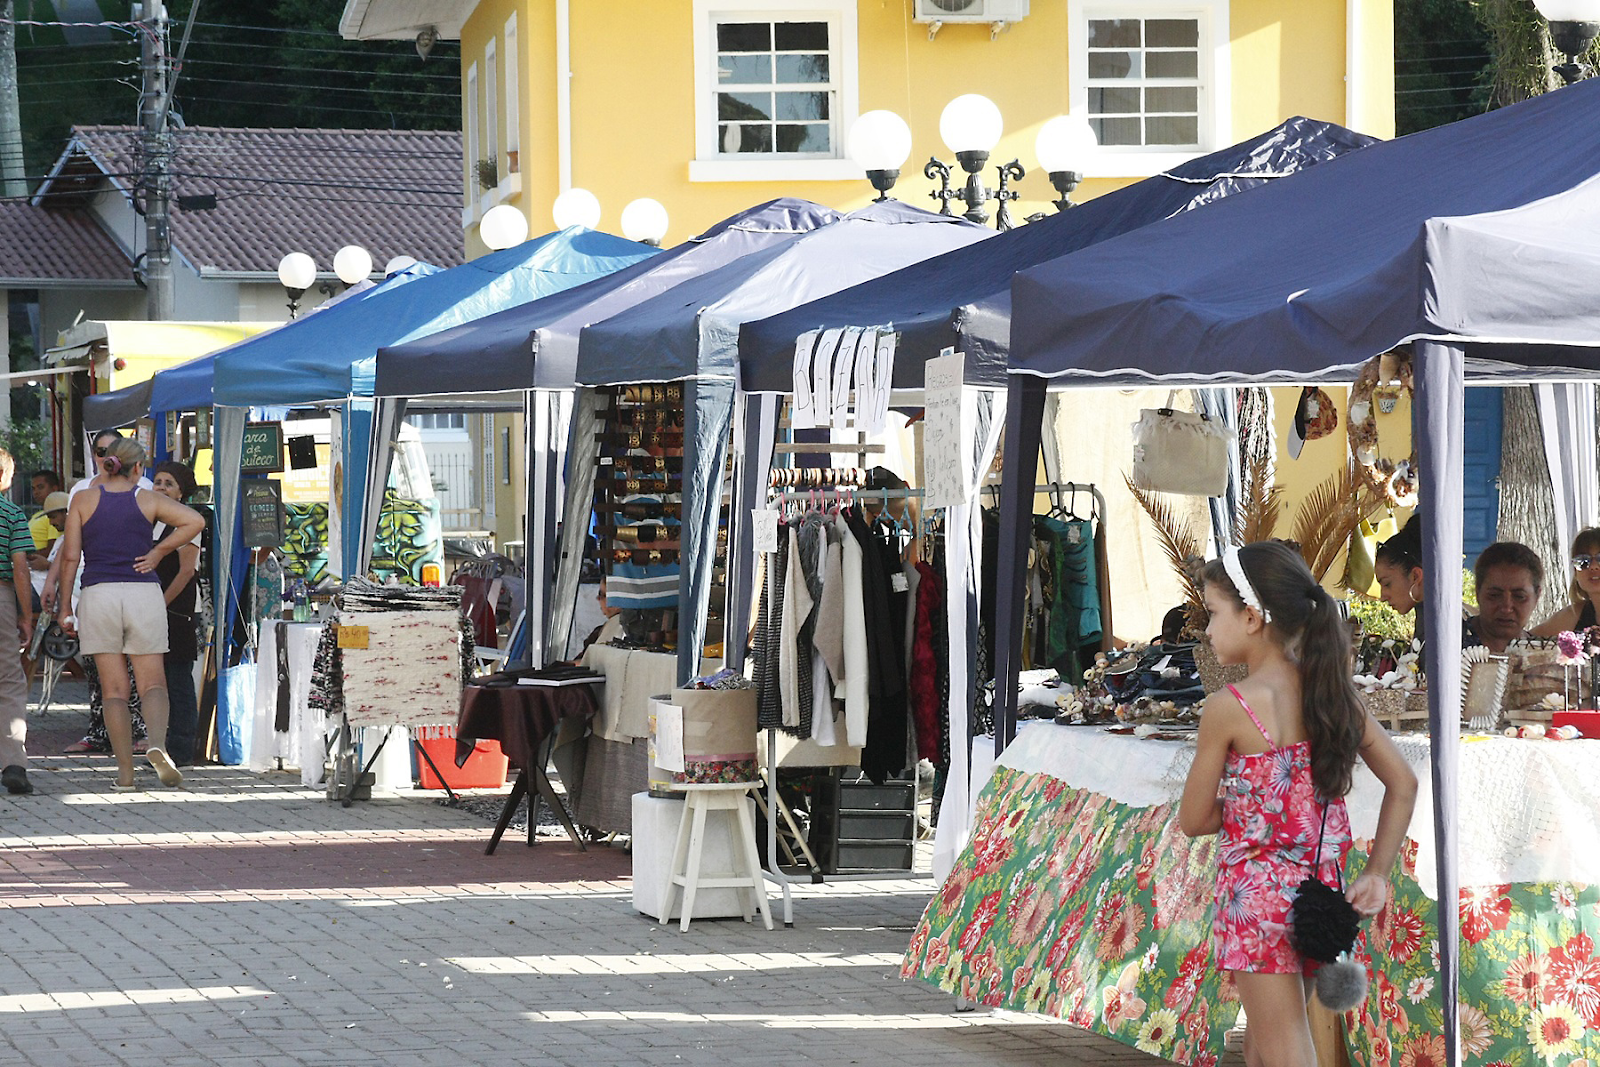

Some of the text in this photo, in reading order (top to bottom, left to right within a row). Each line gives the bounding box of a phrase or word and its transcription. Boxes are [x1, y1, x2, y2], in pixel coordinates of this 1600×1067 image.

[795, 341, 889, 422] BAZAR
[244, 433, 268, 443] ara
[246, 445, 261, 454] de
